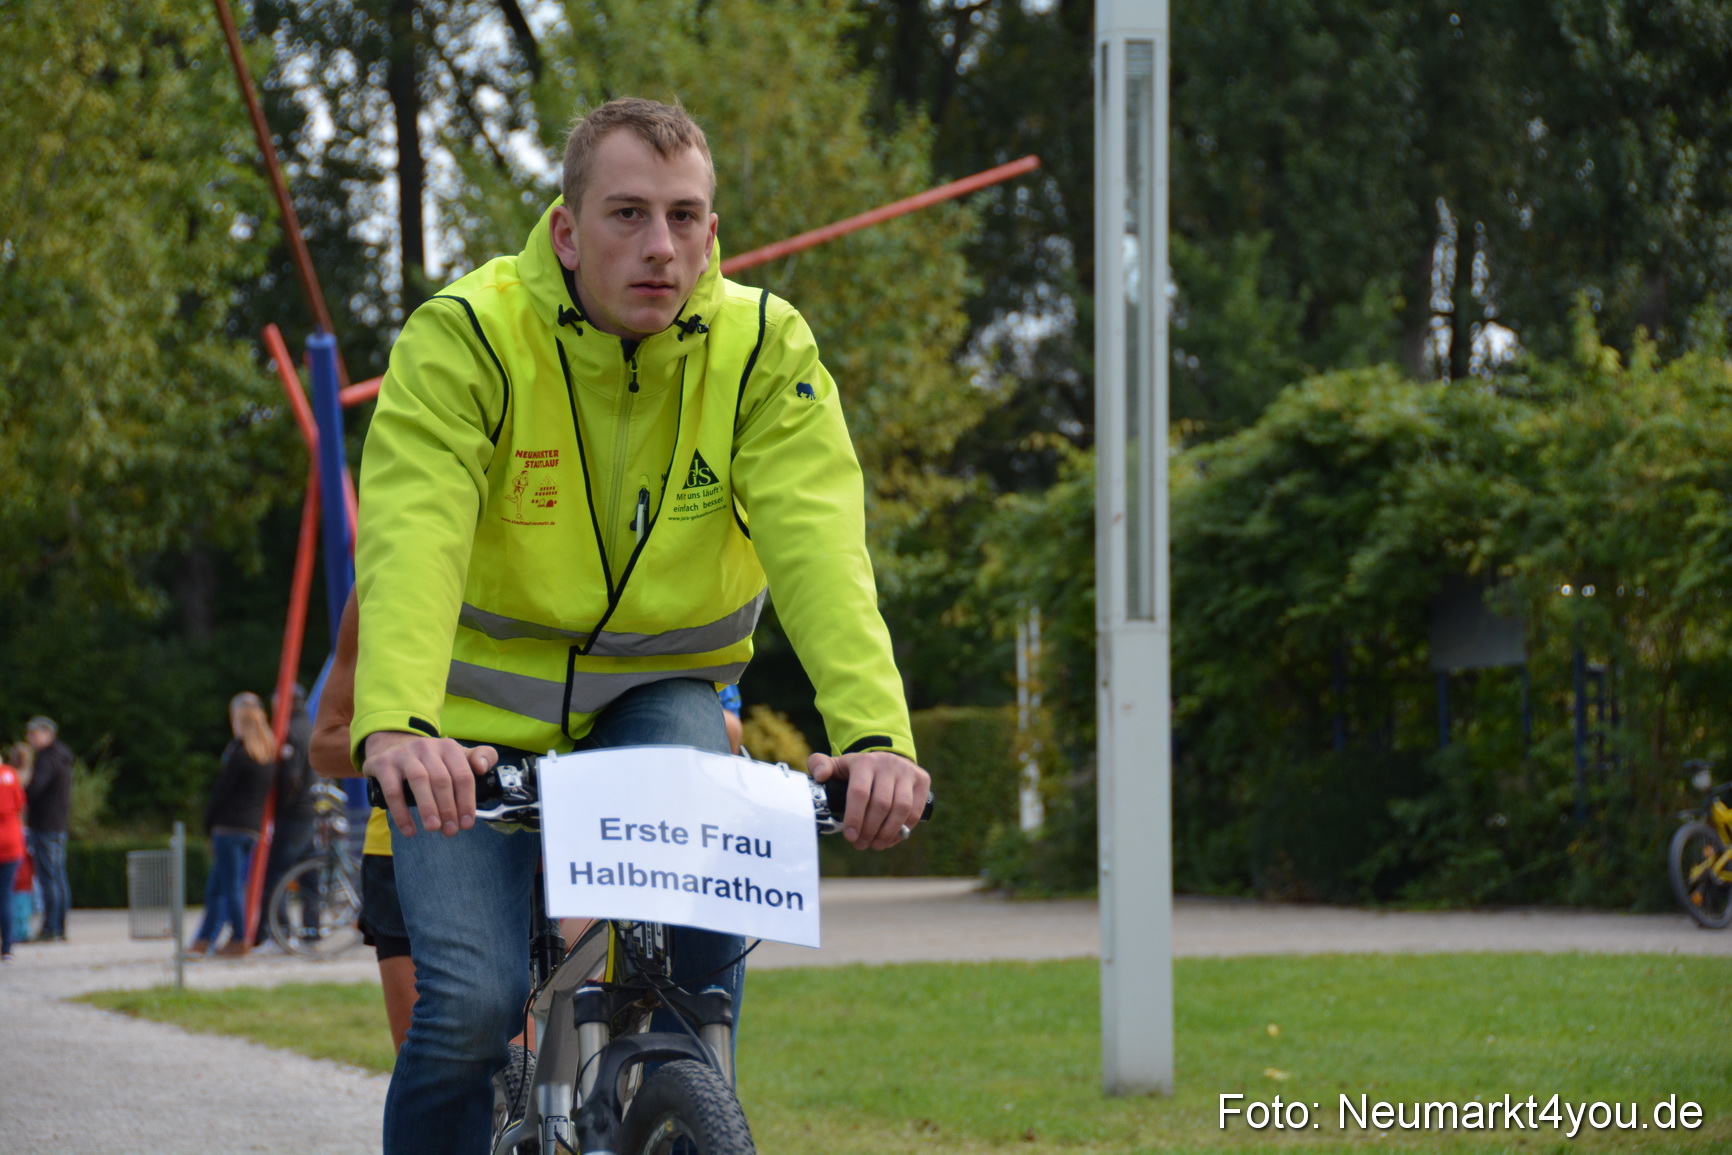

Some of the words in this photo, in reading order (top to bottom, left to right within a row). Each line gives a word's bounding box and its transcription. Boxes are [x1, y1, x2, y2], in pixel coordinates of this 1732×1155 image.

[515, 449, 559, 459] NEUMKTER
[687, 492, 700, 500] uns
[702, 484, 724, 497] läuft's
[673, 503, 699, 512] einfach
[600, 817, 689, 845] Erste
[701, 823, 772, 859] Frau
[569, 861, 804, 911] Halbmarathon
